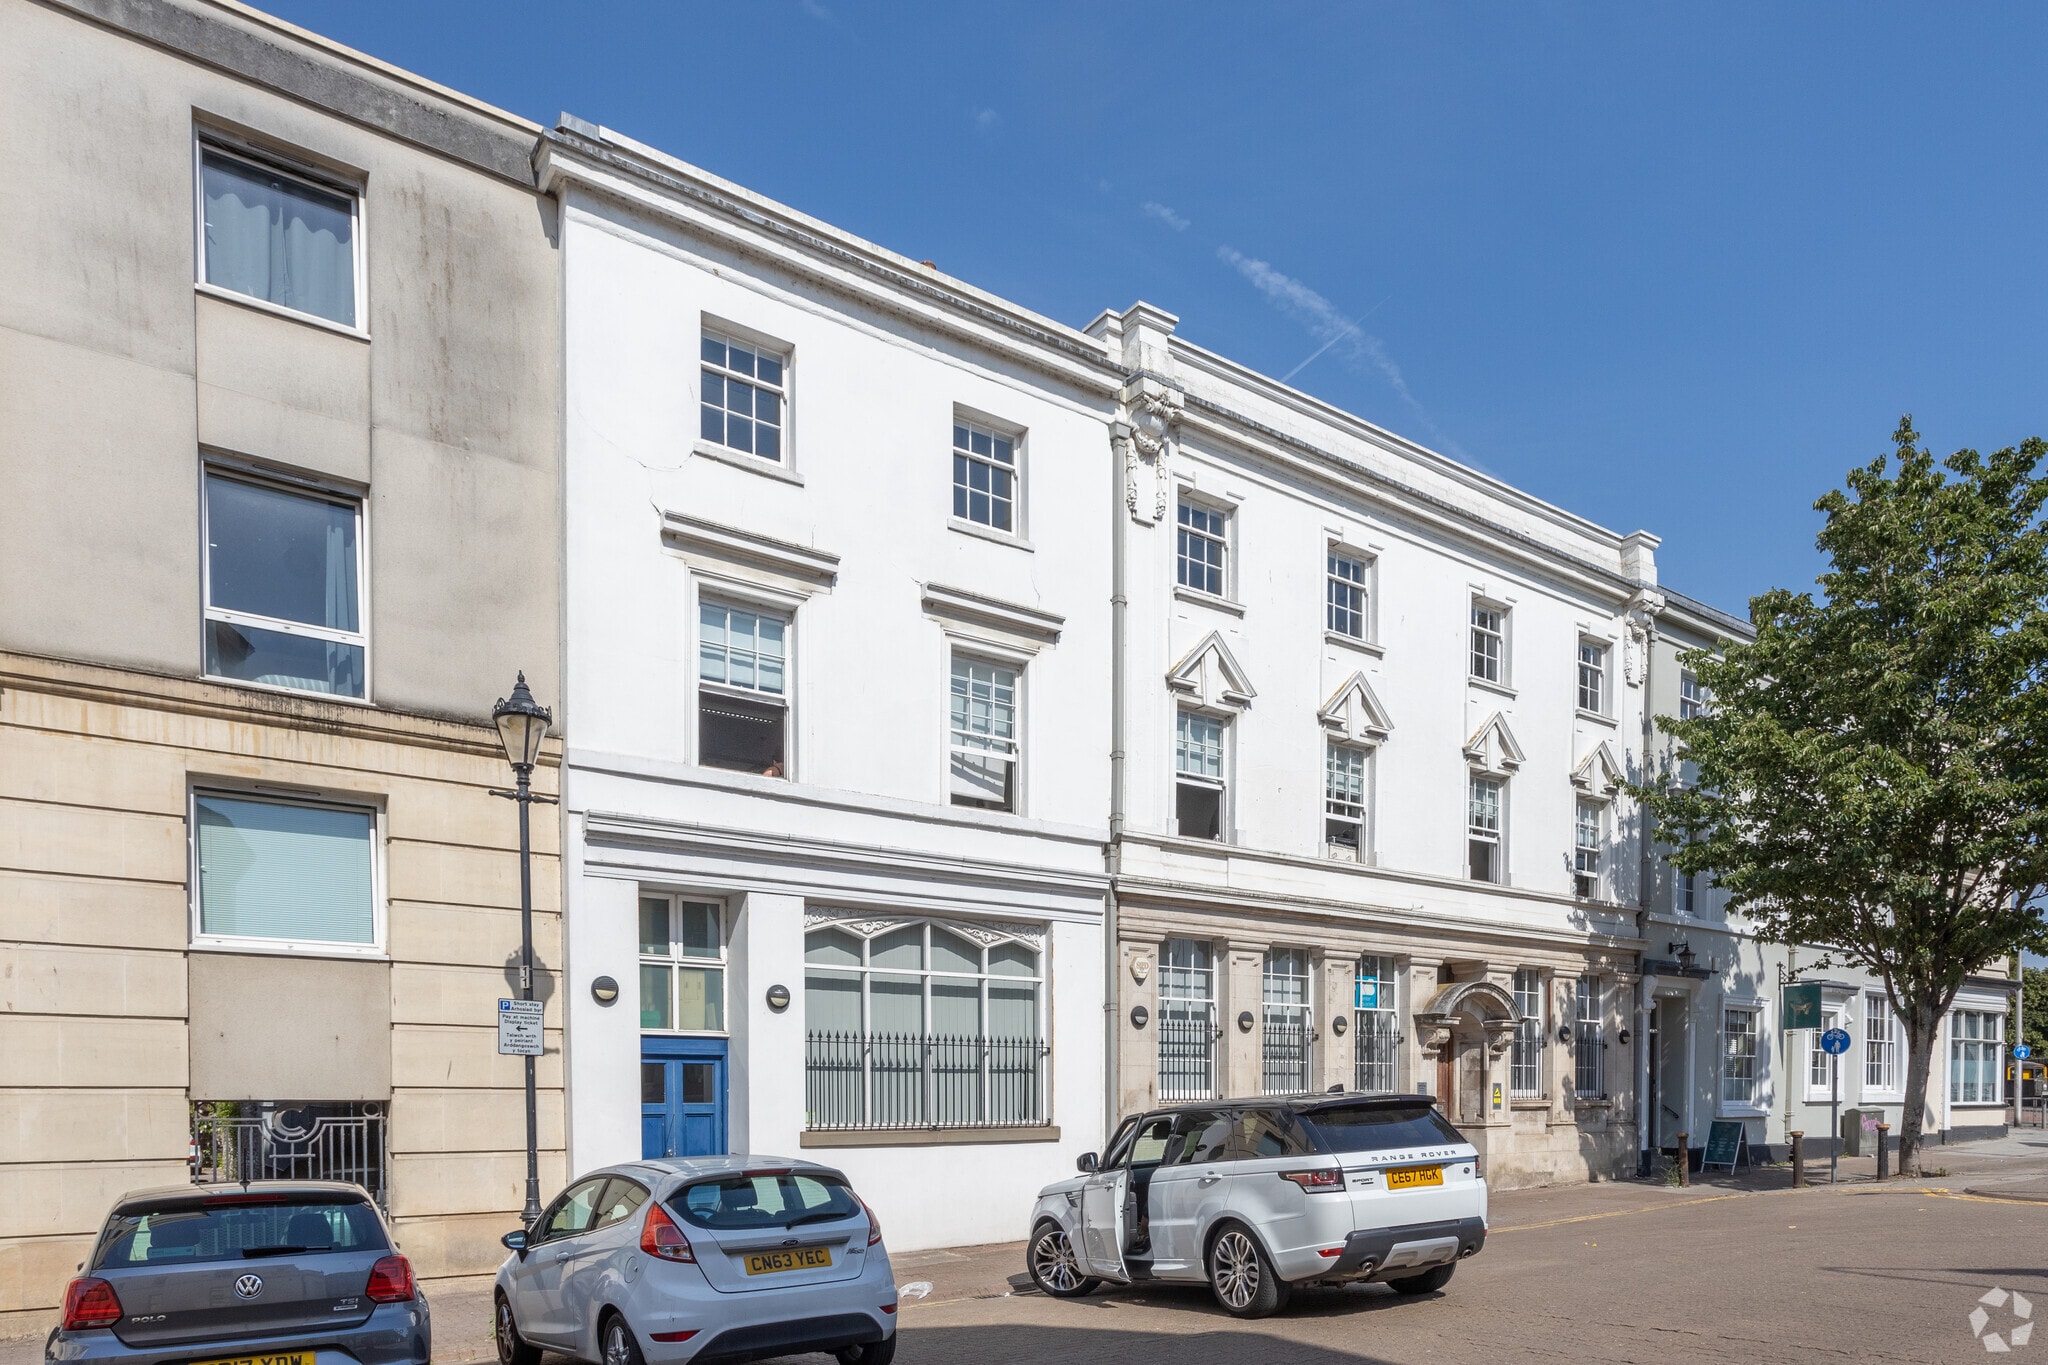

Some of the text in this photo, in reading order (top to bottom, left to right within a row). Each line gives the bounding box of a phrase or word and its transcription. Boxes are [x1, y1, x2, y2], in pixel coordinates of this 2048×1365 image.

[502, 1001, 509, 1010] P
[1371, 1150, 1457, 1162] RANGE ROVER
[1391, 1168, 1439, 1184] CE67 HGK
[751, 1250, 826, 1271] CN63 YEC
[131, 1314, 167, 1324] POLO
